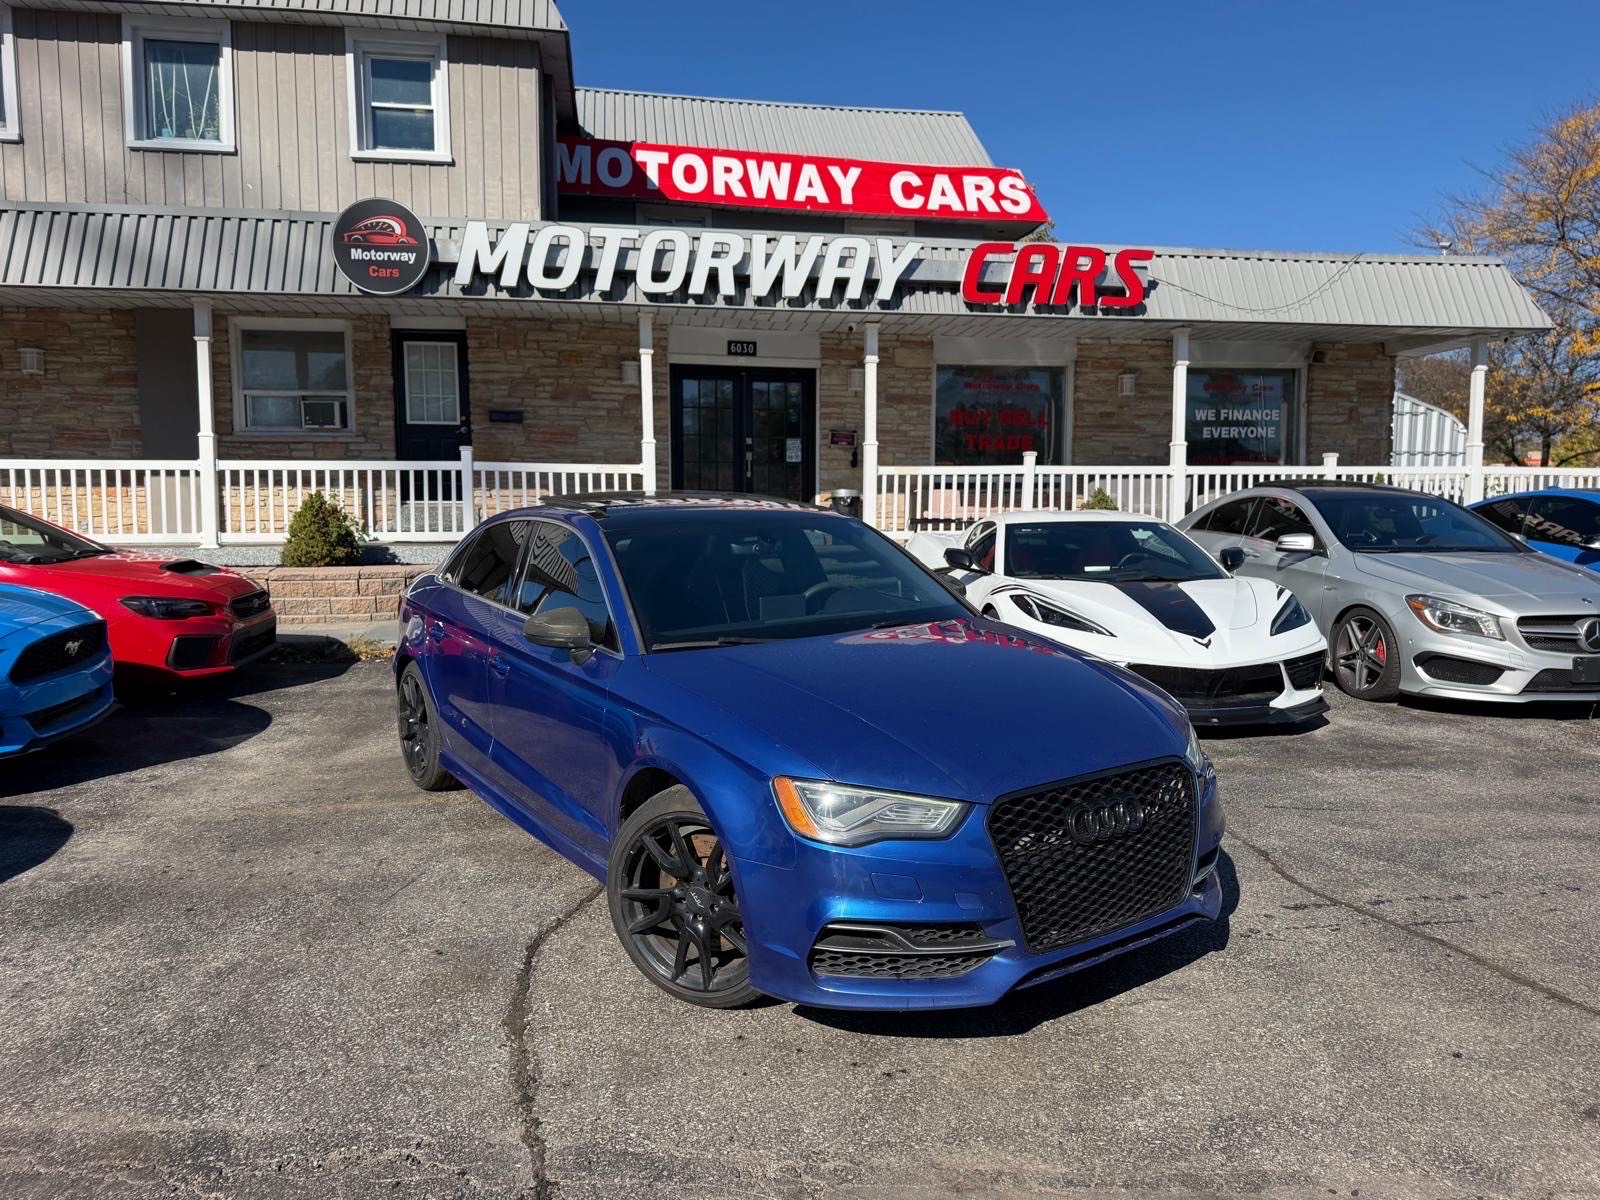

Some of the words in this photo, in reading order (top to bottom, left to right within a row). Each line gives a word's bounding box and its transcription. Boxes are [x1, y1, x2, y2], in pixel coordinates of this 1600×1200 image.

[556, 143, 861, 205] MOTORWAY
[889, 171, 1032, 214] CARS
[351, 248, 416, 264] Motorway
[369, 265, 400, 277] Cars
[454, 221, 923, 301] MOTORWAY
[960, 242, 1154, 308] CARS
[731, 343, 754, 353] 6030
[949, 409, 992, 427] BUY
[998, 409, 1051, 427] SELL
[1195, 409, 1216, 421] WE
[1221, 409, 1280, 421] FINANCE
[1203, 427, 1276, 438] EVERYONE
[965, 434, 1033, 451] TRADE
